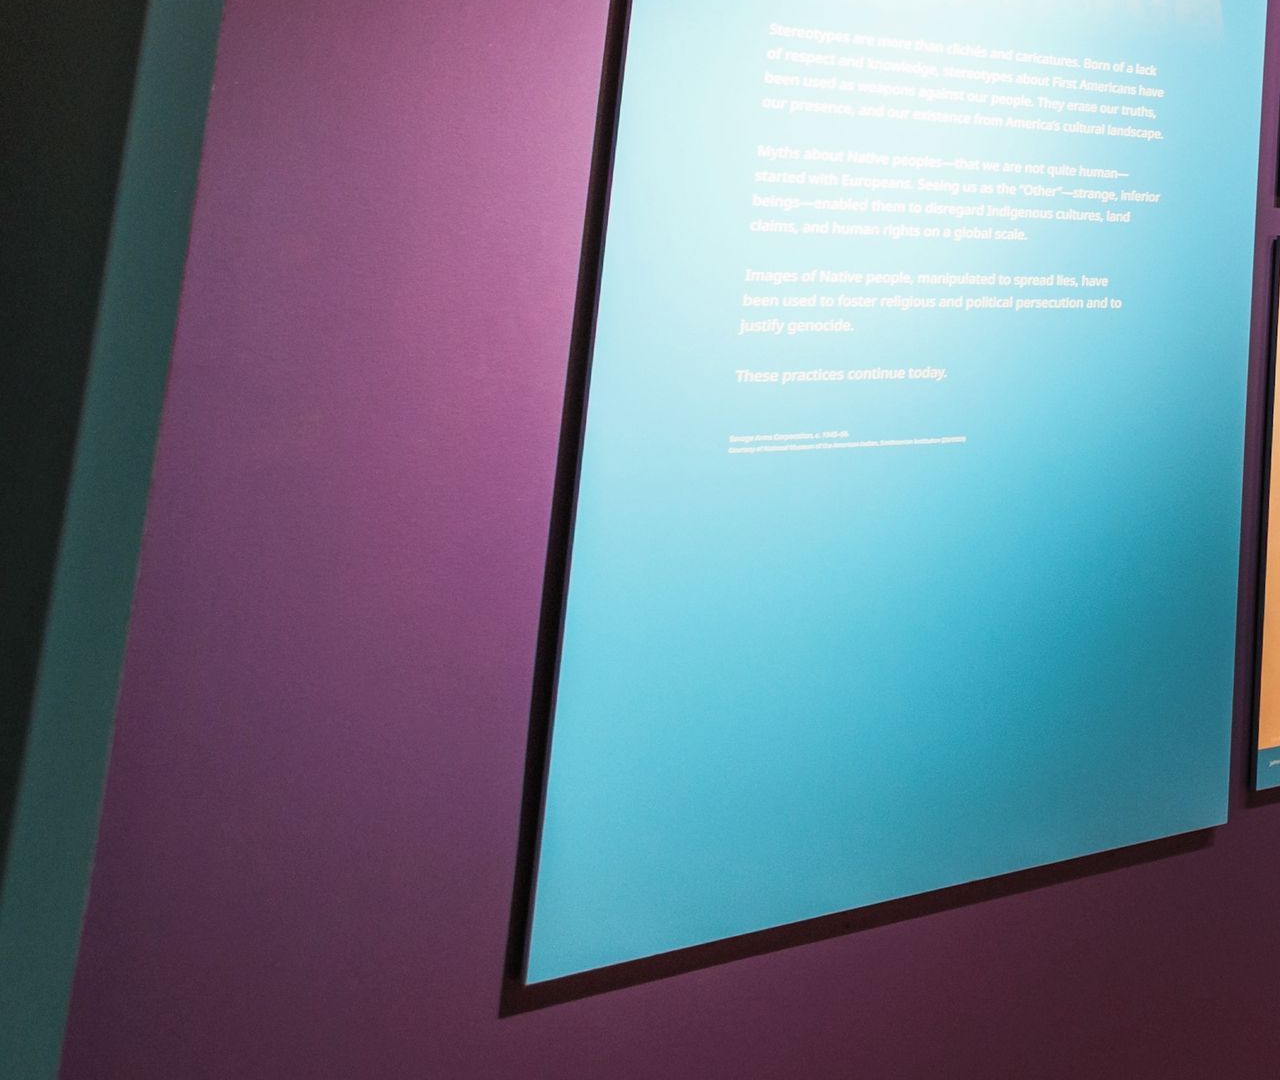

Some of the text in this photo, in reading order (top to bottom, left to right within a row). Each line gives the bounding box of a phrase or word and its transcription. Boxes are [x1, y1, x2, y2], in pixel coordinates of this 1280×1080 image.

[989, 50, 1013, 59] and
[1083, 58, 1110, 70] Born
[1112, 61, 1124, 71] of
[1135, 64, 1156, 75] lack
[980, 162, 1000, 171] we
[1001, 162, 1022, 172] are
[1024, 164, 1045, 173] not
[960, 184, 978, 192] us
[978, 184, 993, 193] as
[995, 183, 1016, 194] the
[1120, 190, 1160, 201] inferior
[986, 206, 1053, 218] Indigenous
[1106, 210, 1131, 222] land
[952, 227, 992, 240] global
[996, 274, 1012, 285] to
[1012, 276, 1054, 286] spread
[1081, 275, 1108, 286] have
[819, 296, 834, 306] to
[938, 296, 963, 307] and
[965, 296, 1013, 308] political
[1015, 298, 1084, 309] persecution
[1086, 297, 1108, 308] and
[1108, 298, 1122, 308] to
[738, 319, 784, 334] justify
[735, 367, 947, 382] These practices continue today.
